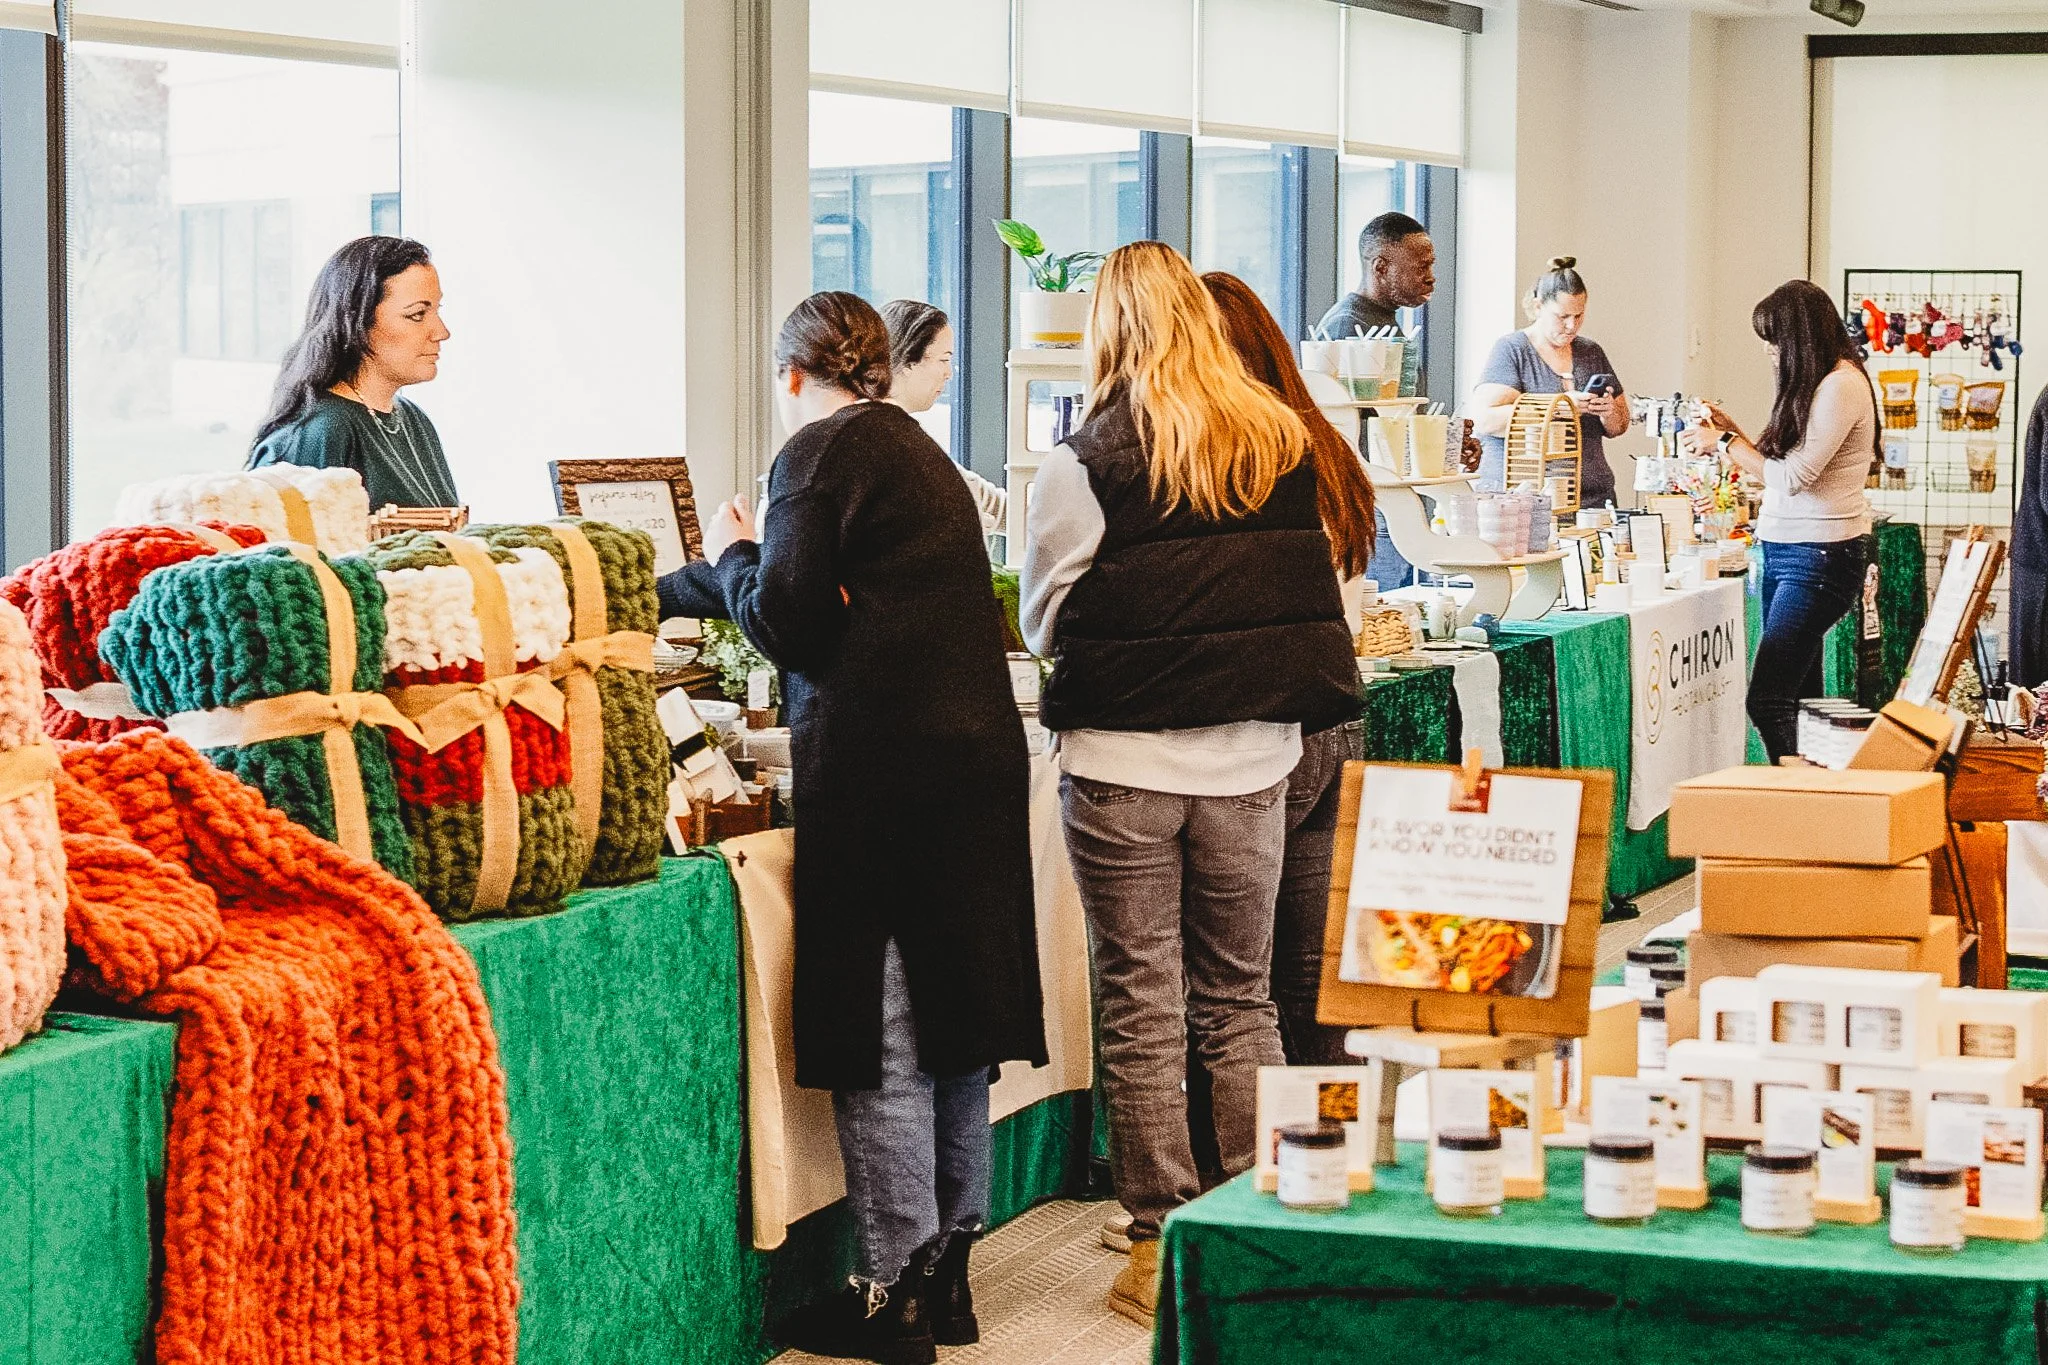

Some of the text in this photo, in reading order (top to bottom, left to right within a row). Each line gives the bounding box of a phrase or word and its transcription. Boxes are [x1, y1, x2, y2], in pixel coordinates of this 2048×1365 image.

[1669, 618, 1734, 689] CHIRON
[1370, 816, 1557, 845] FLAVOR YOU DIDN'T
[1443, 842, 1482, 859] YOU
[1486, 845, 1558, 864] NEEDED
